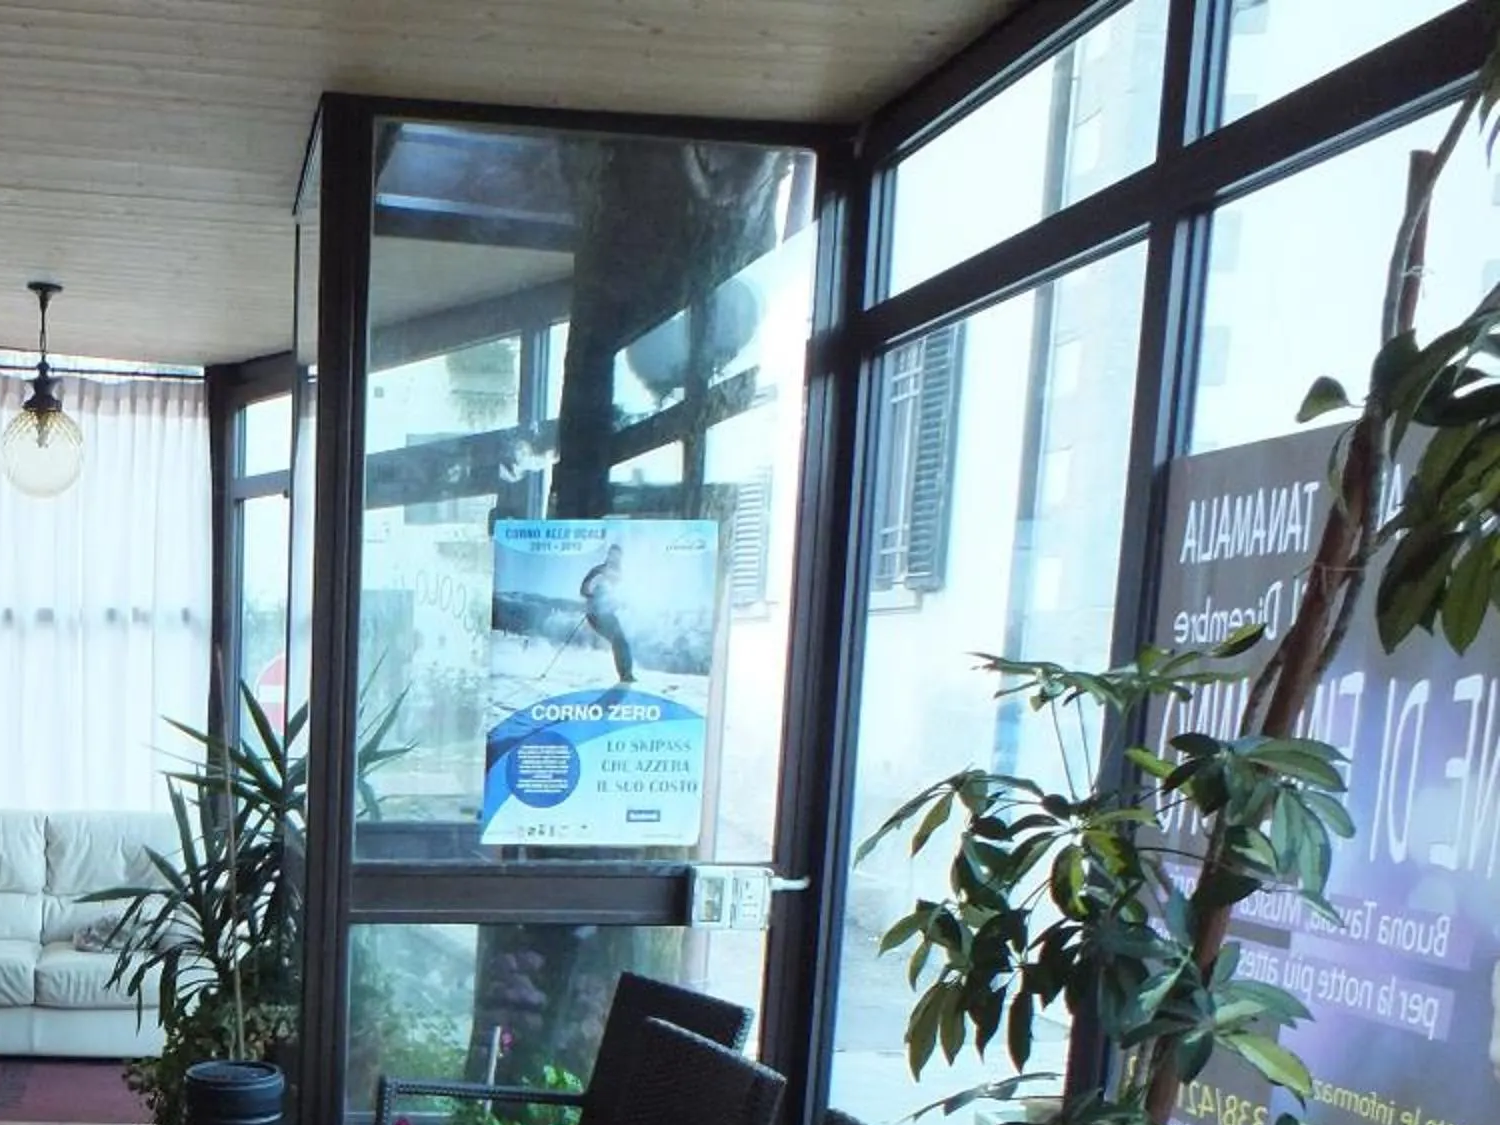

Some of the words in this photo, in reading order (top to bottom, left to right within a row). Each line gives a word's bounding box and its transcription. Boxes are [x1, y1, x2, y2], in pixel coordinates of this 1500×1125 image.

[531, 704, 603, 721] CORNO
[607, 704, 661, 721] ZERO
[606, 740, 625, 752] LO
[630, 740, 692, 754] SKIPASS
[601, 759, 629, 773] CHE
[634, 759, 690, 773] AZZERA
[596, 779, 613, 792] IL
[615, 780, 644, 793] SUO
[649, 780, 699, 794] COSTO
